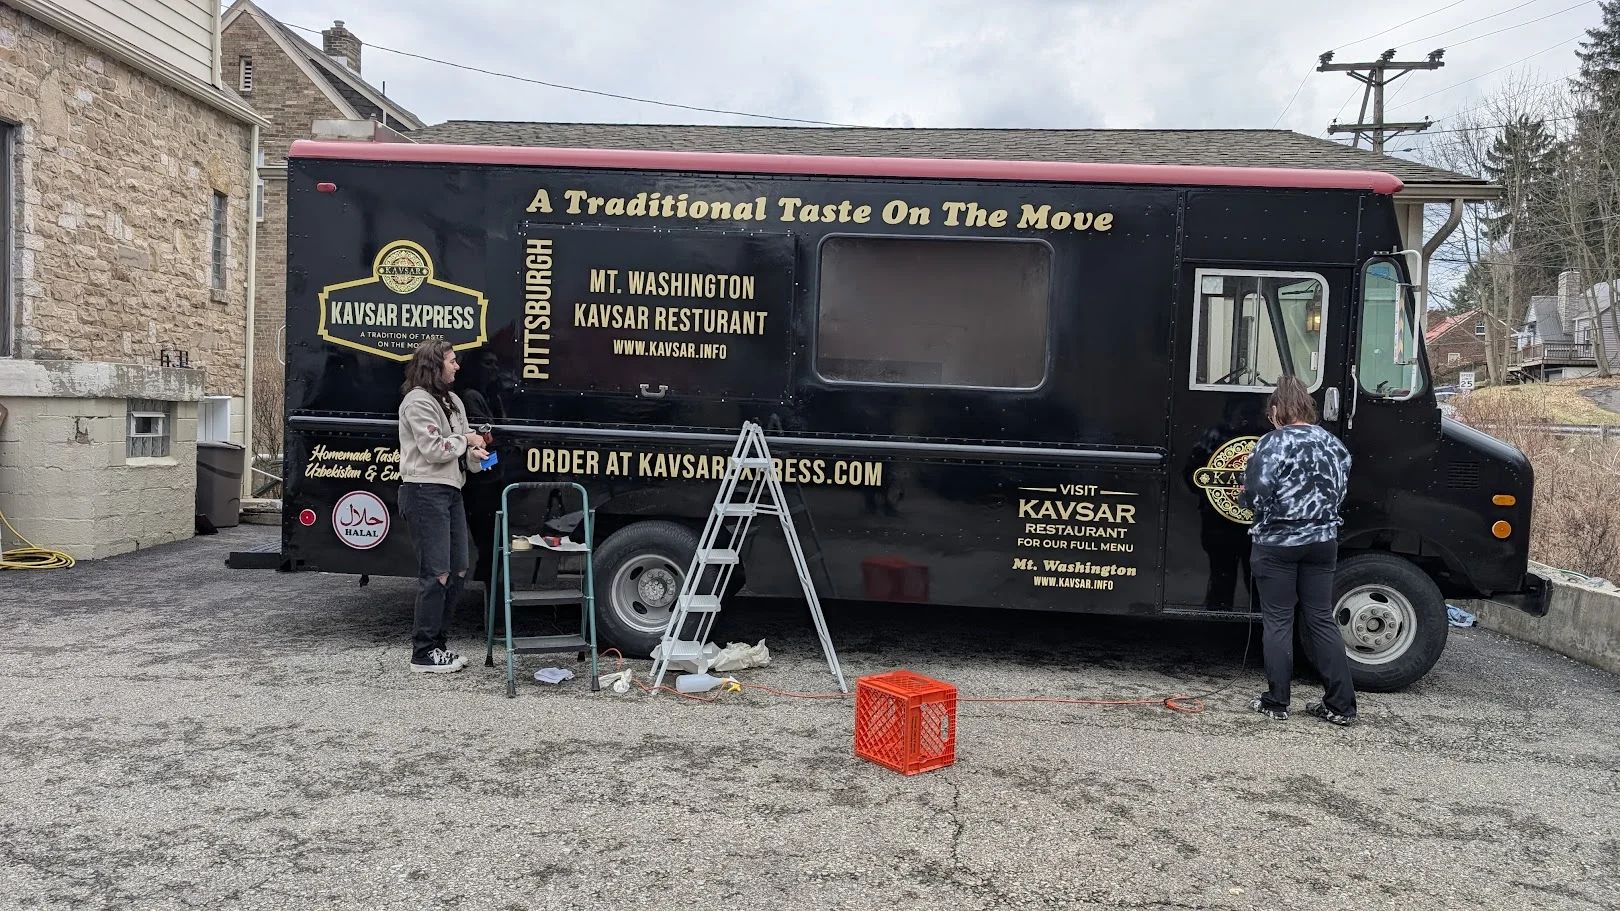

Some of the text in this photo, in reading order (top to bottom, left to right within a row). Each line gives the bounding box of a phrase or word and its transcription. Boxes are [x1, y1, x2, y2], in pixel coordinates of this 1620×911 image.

[526, 188, 1114, 231] A Traditional Taste On The Move
[385, 267, 421, 275] KAVSAR
[589, 269, 755, 300] MT. WASHINGTON
[331, 301, 474, 330] KAVSAR EXPRESS
[523, 239, 552, 379] PITTSBURGH
[574, 303, 768, 335] KAVSAR RESTURANT
[367, 331, 407, 339] TRADITION
[613, 339, 727, 359] WWW.KAVSAR.INFO
[308, 444, 371, 463] Homemade
[526, 448, 600, 475] ORDER
[605, 451, 632, 477] AT
[304, 462, 400, 482] Uzbekistan & Eur
[1060, 484, 1098, 496] VISIT
[340, 503, 384, 527] حلال
[1018, 499, 1136, 524] KAVSAR
[345, 528, 379, 538] HALAL
[1025, 523, 1128, 539] RESTAURANT
[1017, 538, 1134, 553] FOR OUR FULL MENU
[1012, 558, 1137, 577] Mt. Washington
[1033, 576, 1114, 590] WWW.KAVSAR.INFO
